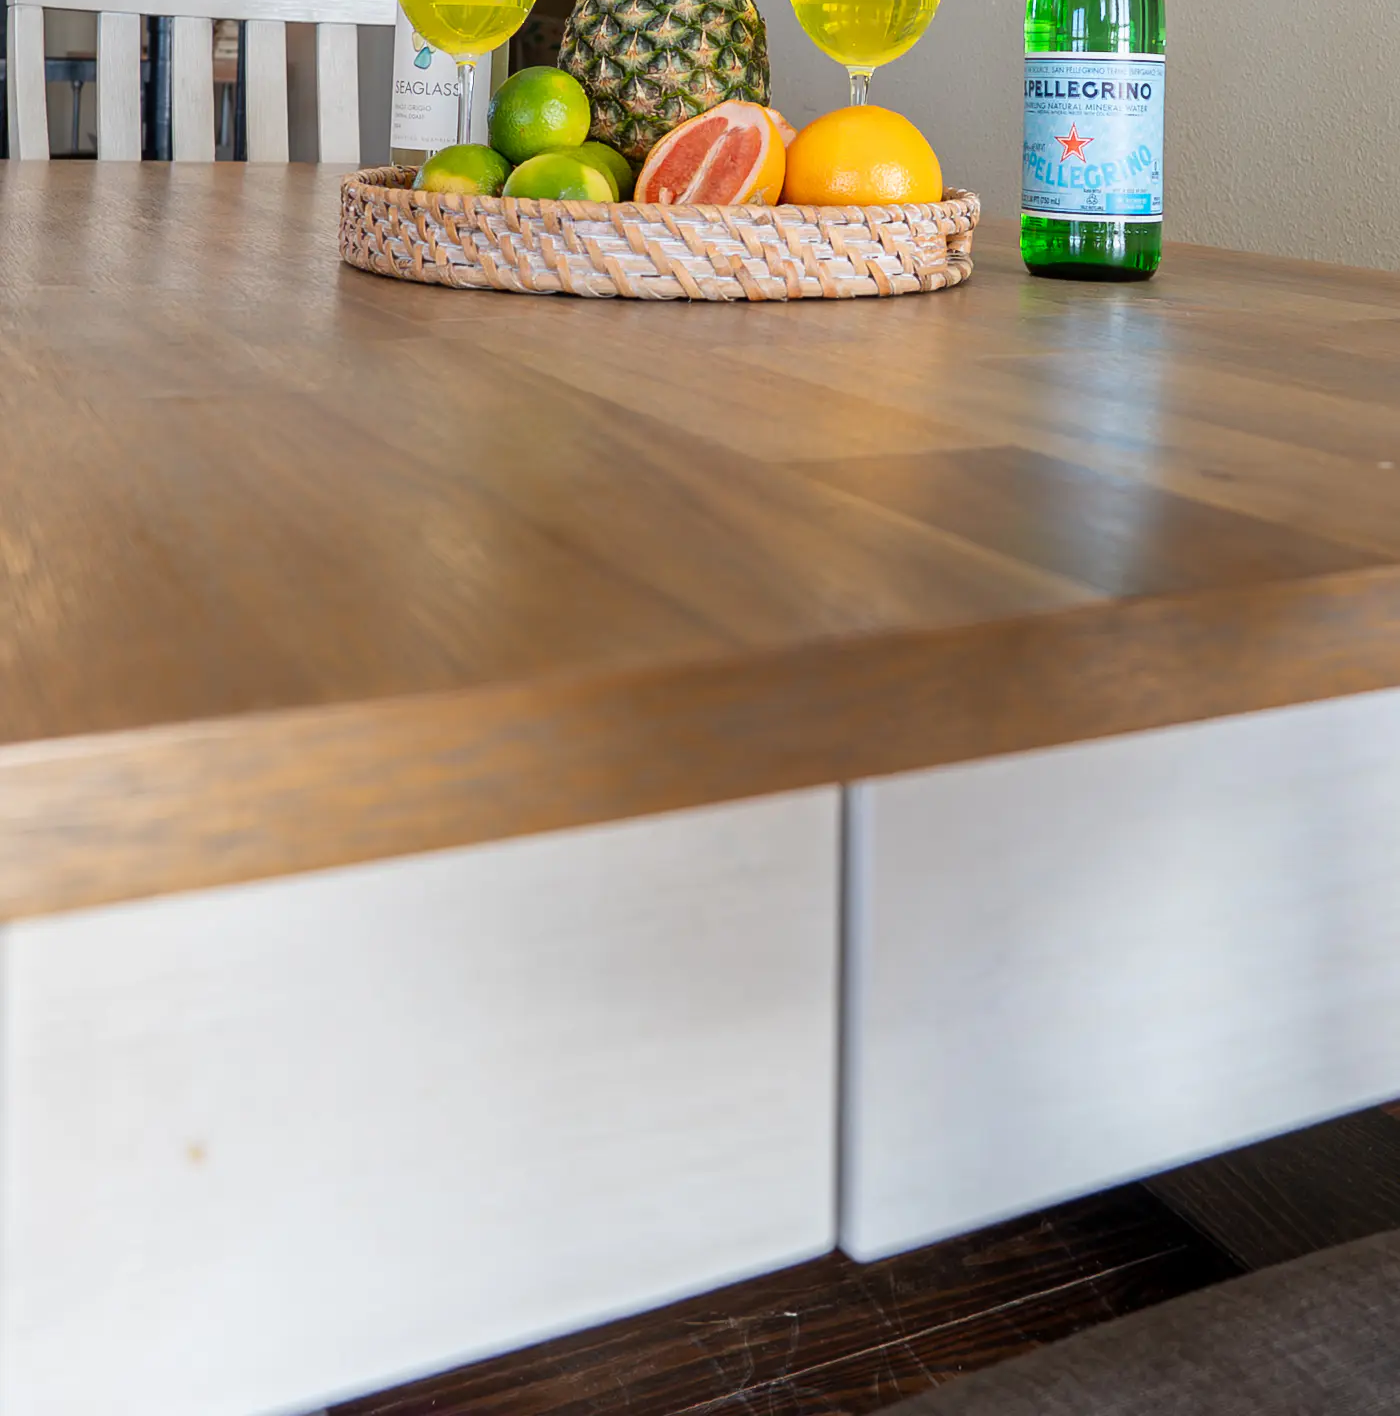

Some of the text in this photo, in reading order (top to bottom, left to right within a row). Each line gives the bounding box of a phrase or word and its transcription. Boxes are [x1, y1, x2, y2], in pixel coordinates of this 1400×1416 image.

[1051, 66, 1064, 74] SAN
[395, 80, 459, 97] SEAGLASS
[1047, 102, 1082, 111] NATURAL
[1085, 103, 1122, 112] MINERAL
[1125, 104, 1148, 113] WATER
